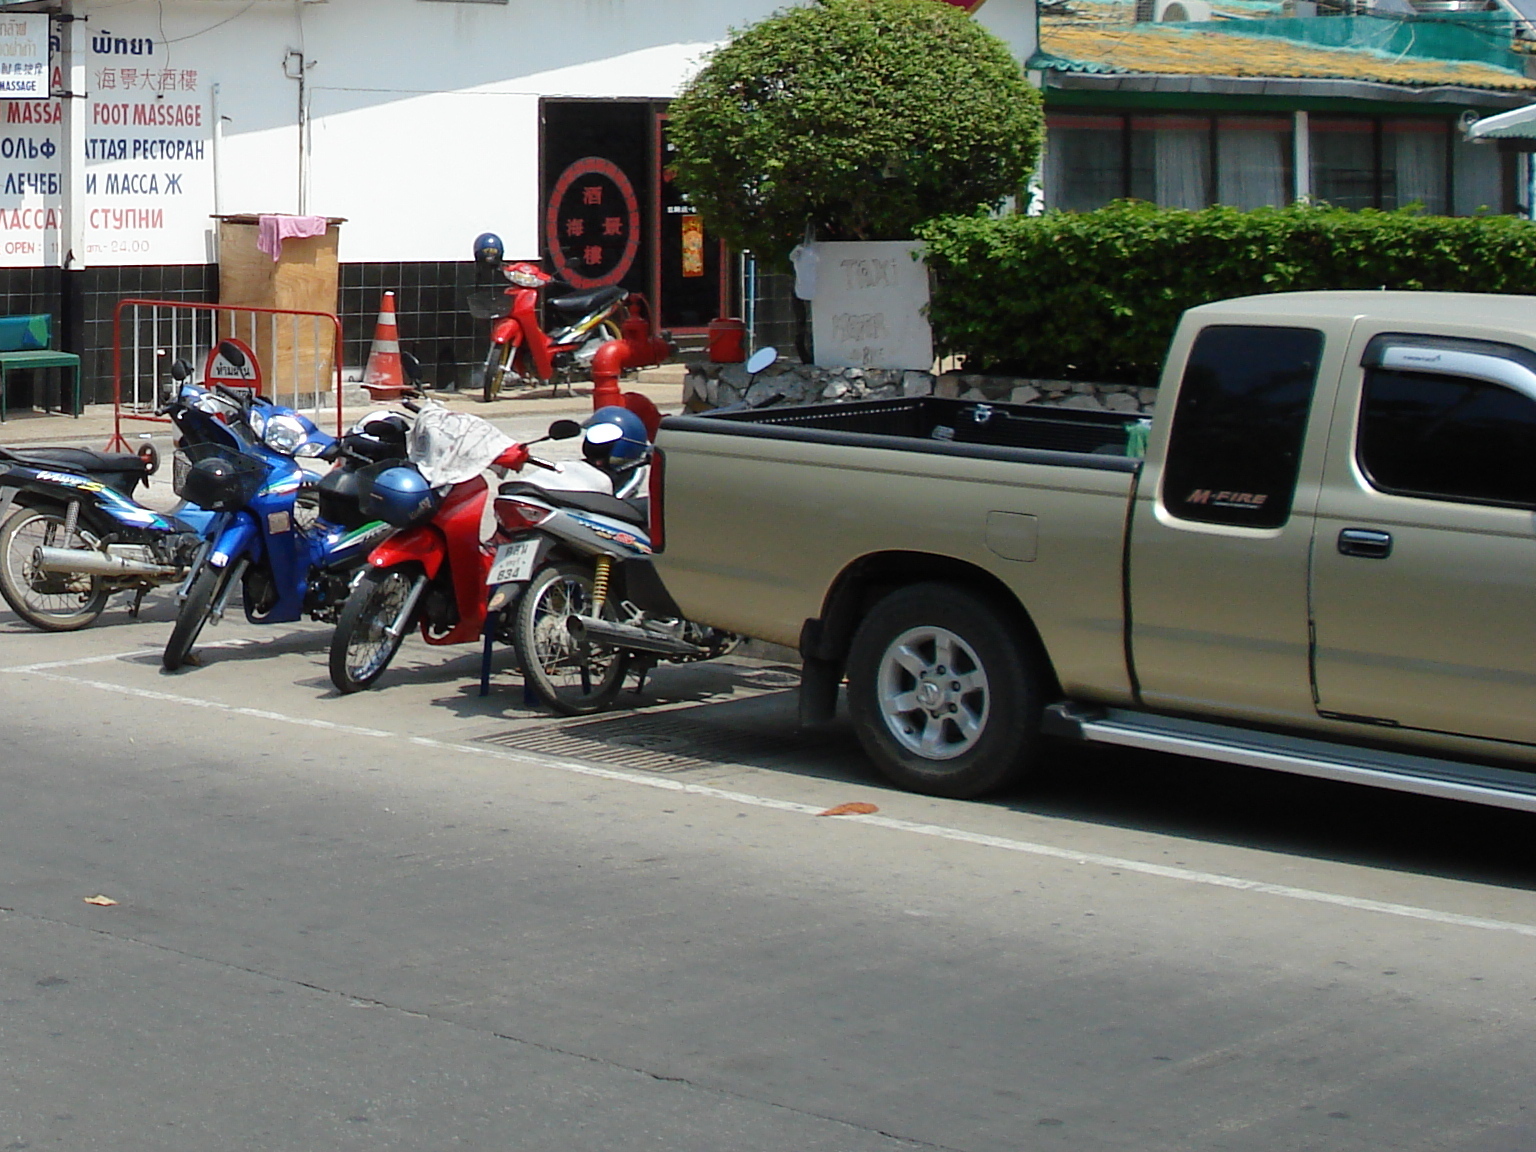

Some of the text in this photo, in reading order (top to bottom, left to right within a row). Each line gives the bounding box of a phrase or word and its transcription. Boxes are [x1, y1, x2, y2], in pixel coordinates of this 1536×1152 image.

[92, 30, 153, 55] พัทยา
[0, 80, 37, 92] MASSAGE
[94, 66, 198, 91] 海景大酒樓
[7, 101, 62, 124] MASSA
[93, 103, 130, 126] FOOT
[133, 104, 201, 127] MASSAGE
[133, 139, 204, 161] РЕСТОРАН
[89, 208, 164, 231] СТУПНИ
